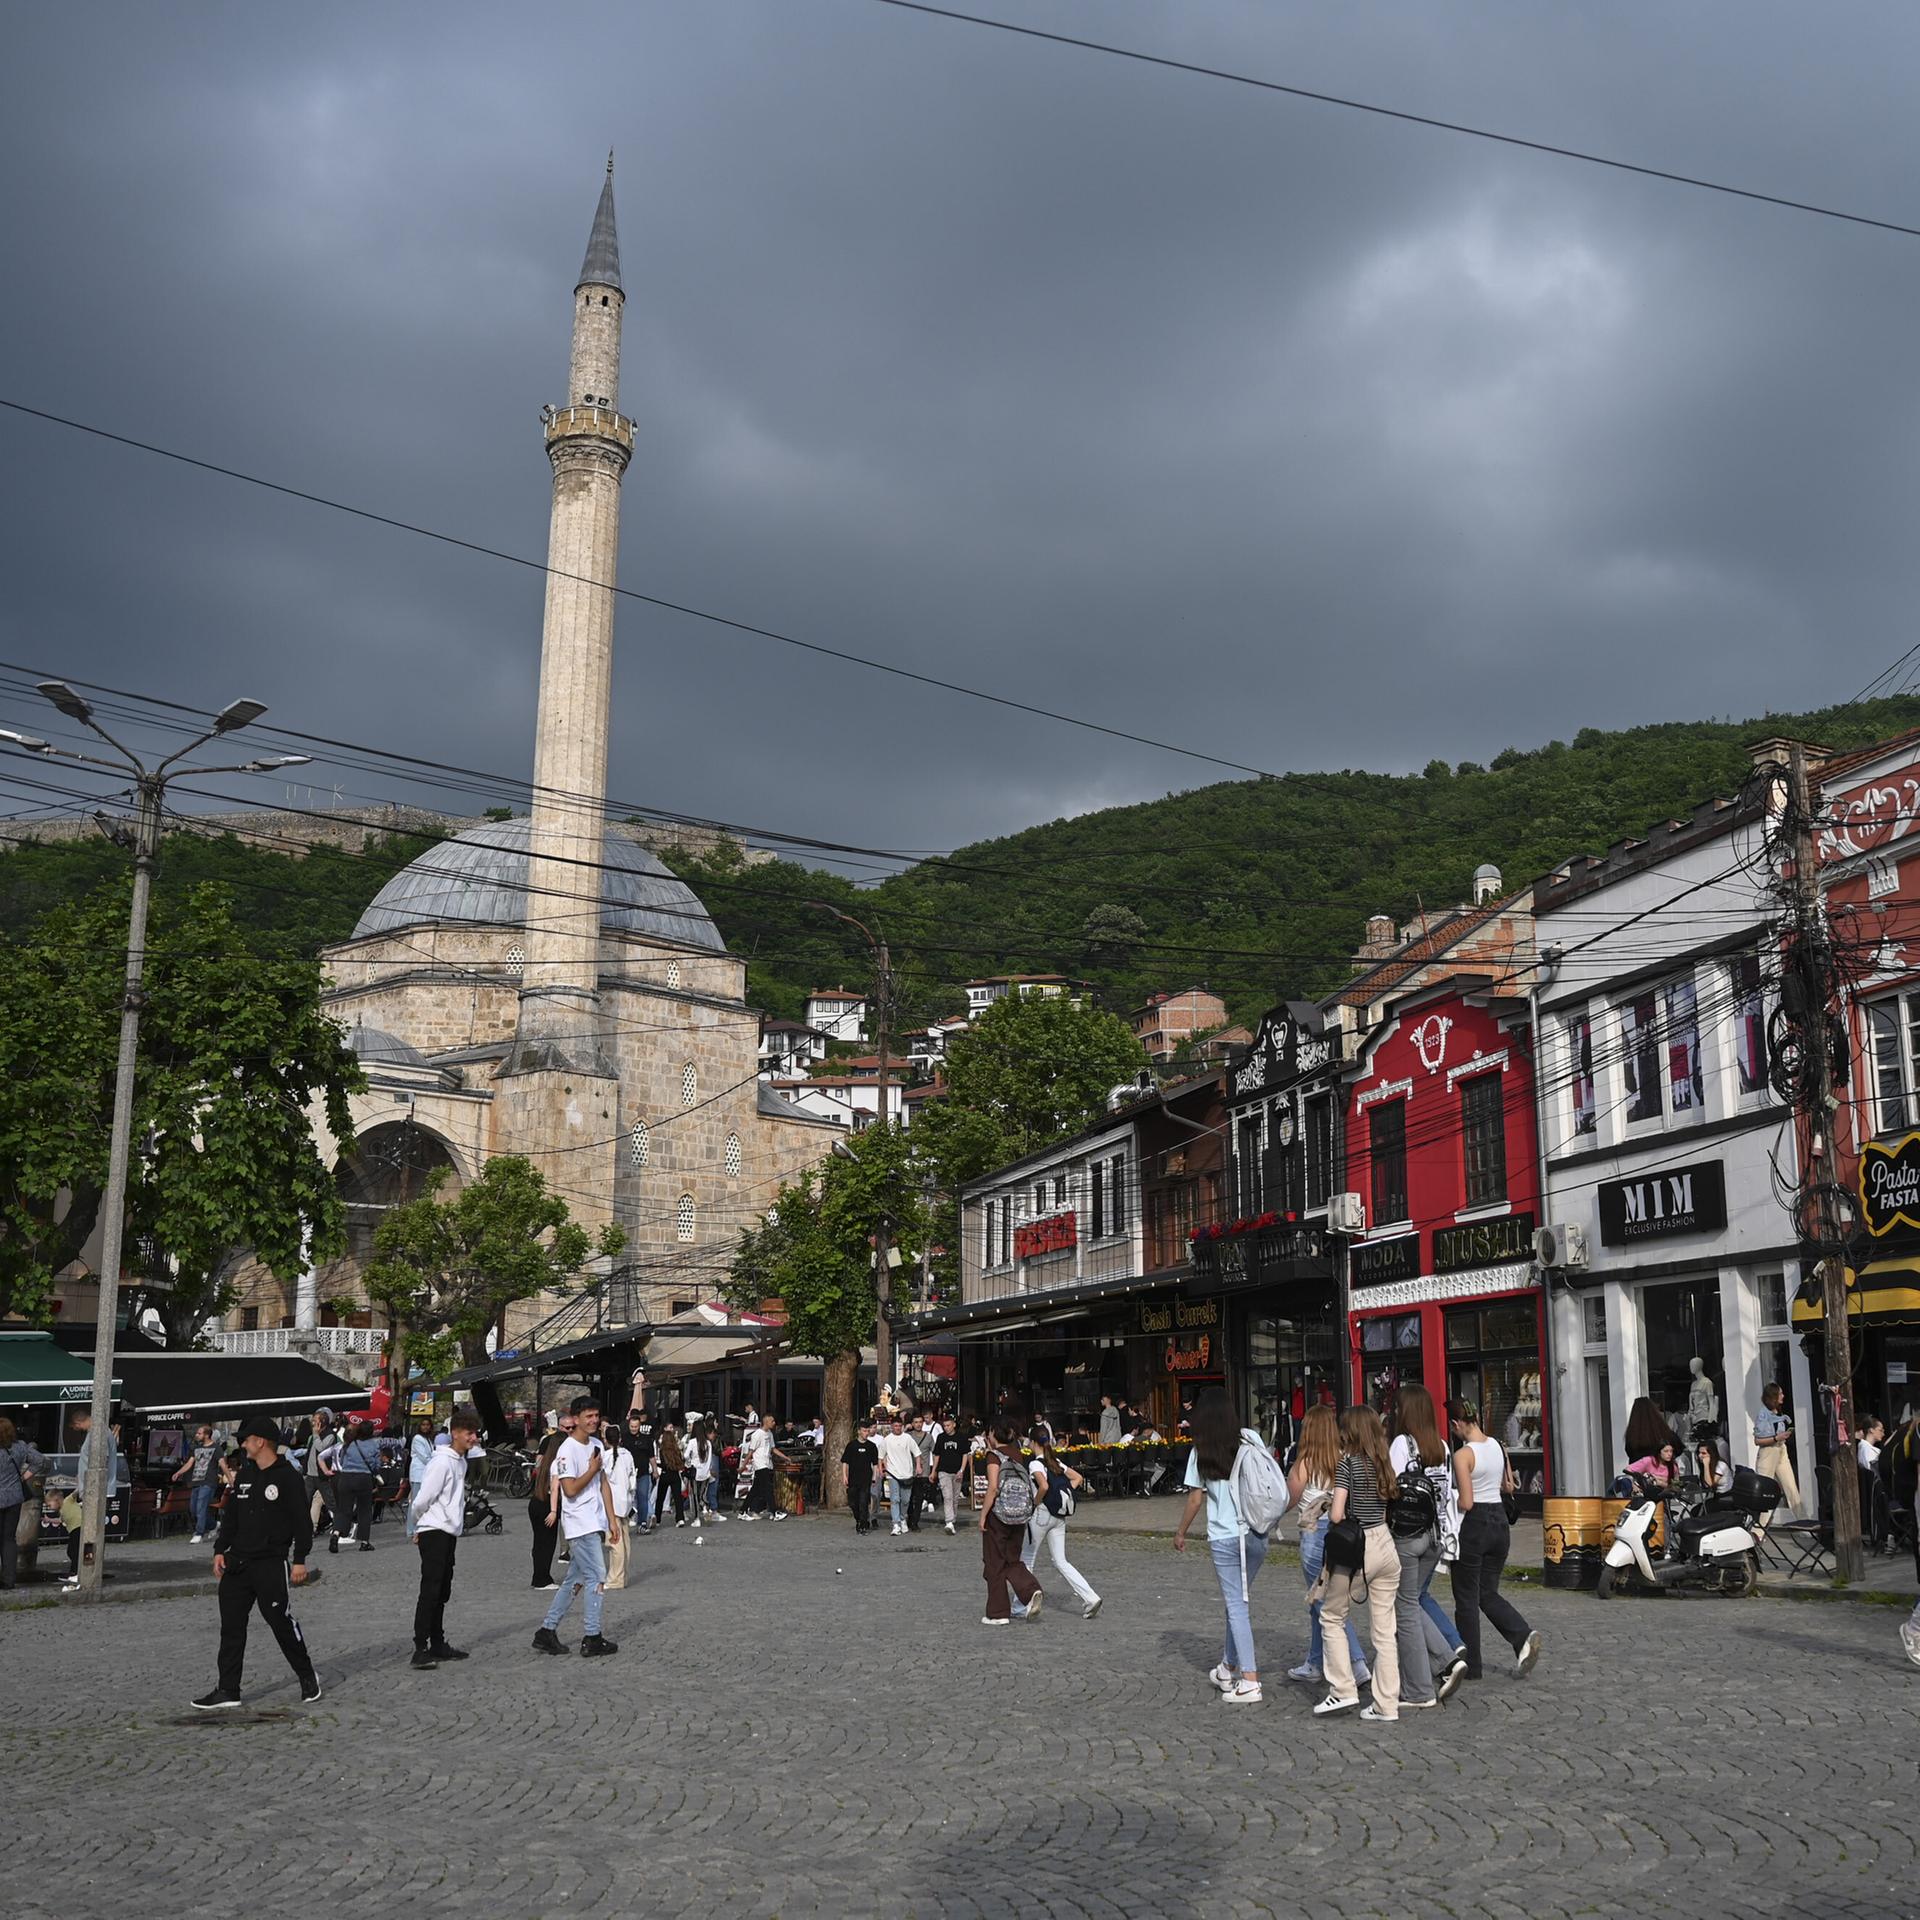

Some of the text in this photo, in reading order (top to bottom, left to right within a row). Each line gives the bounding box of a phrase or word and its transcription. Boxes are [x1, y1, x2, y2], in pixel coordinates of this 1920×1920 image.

[1871, 1160, 1920, 1198] Pasta
[1622, 1173, 1694, 1224] MIM
[1880, 1188, 1919, 1210] FASTA
[1624, 1216, 1695, 1236] EXCLUSIVE FASHION
[1361, 1243, 1406, 1271] MODA
[147, 1414, 167, 1422] PRINCE
